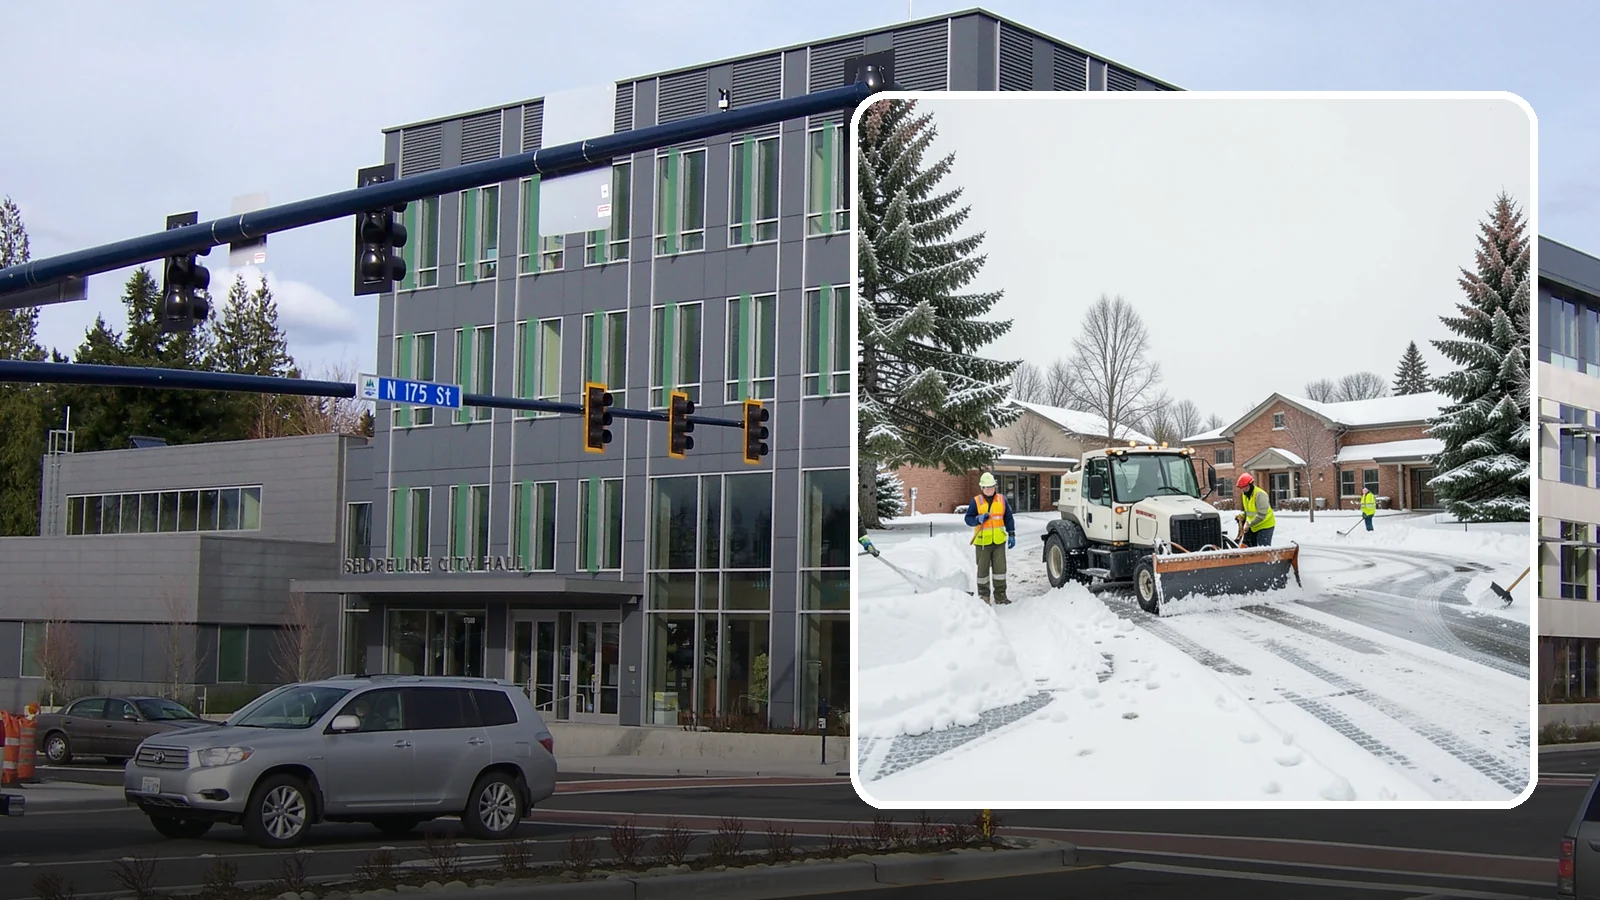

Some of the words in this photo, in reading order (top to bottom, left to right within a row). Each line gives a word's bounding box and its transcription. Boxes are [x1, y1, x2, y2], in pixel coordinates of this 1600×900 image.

[387, 380, 397, 400] N
[405, 382, 428, 403] 175
[436, 386, 451, 406] St
[344, 556, 432, 575] SHORELINE
[438, 556, 476, 573] CITY
[484, 555, 525, 573] HALL
